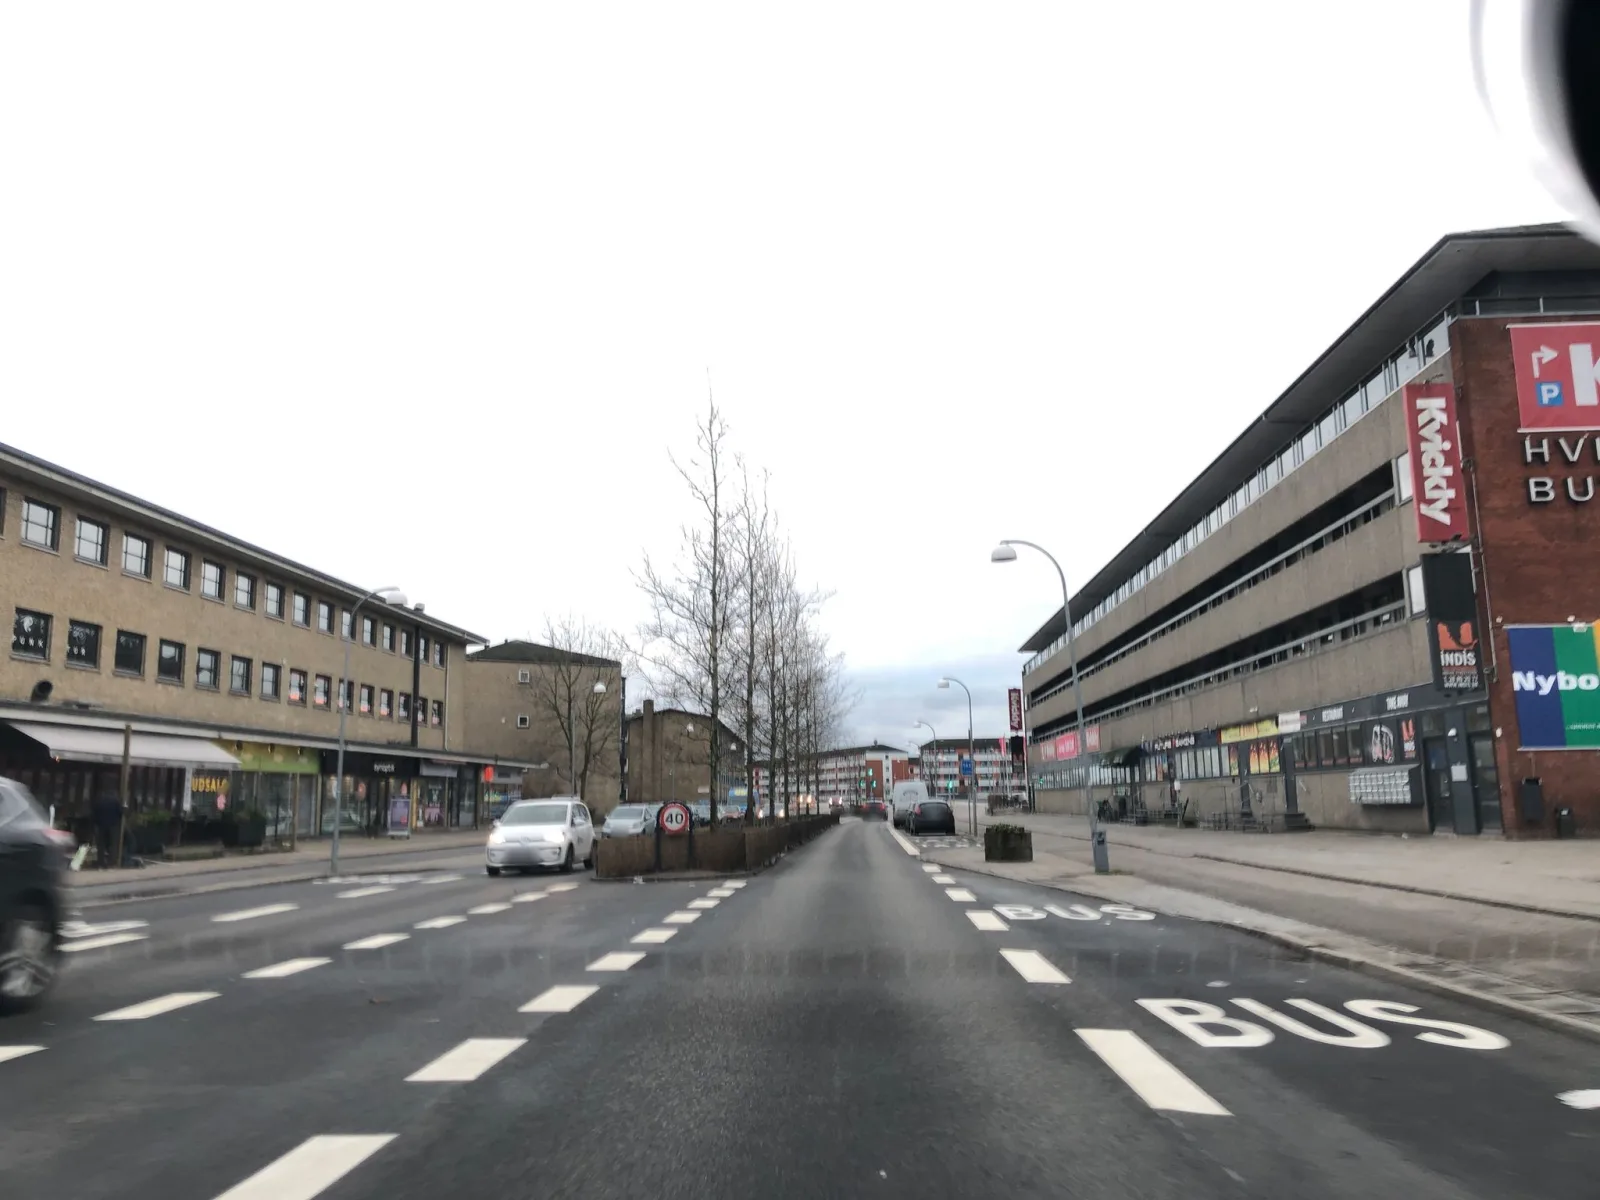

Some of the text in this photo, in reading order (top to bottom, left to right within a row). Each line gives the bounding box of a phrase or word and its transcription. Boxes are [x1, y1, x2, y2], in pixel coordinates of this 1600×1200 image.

[1416, 397, 1456, 525] Kvickly
[1529, 476, 1595, 502] BU
[1512, 670, 1600, 695] Nybo
[665, 812, 684, 825] 40
[993, 899, 1156, 920] BUS
[1135, 998, 1510, 1050] BUS
